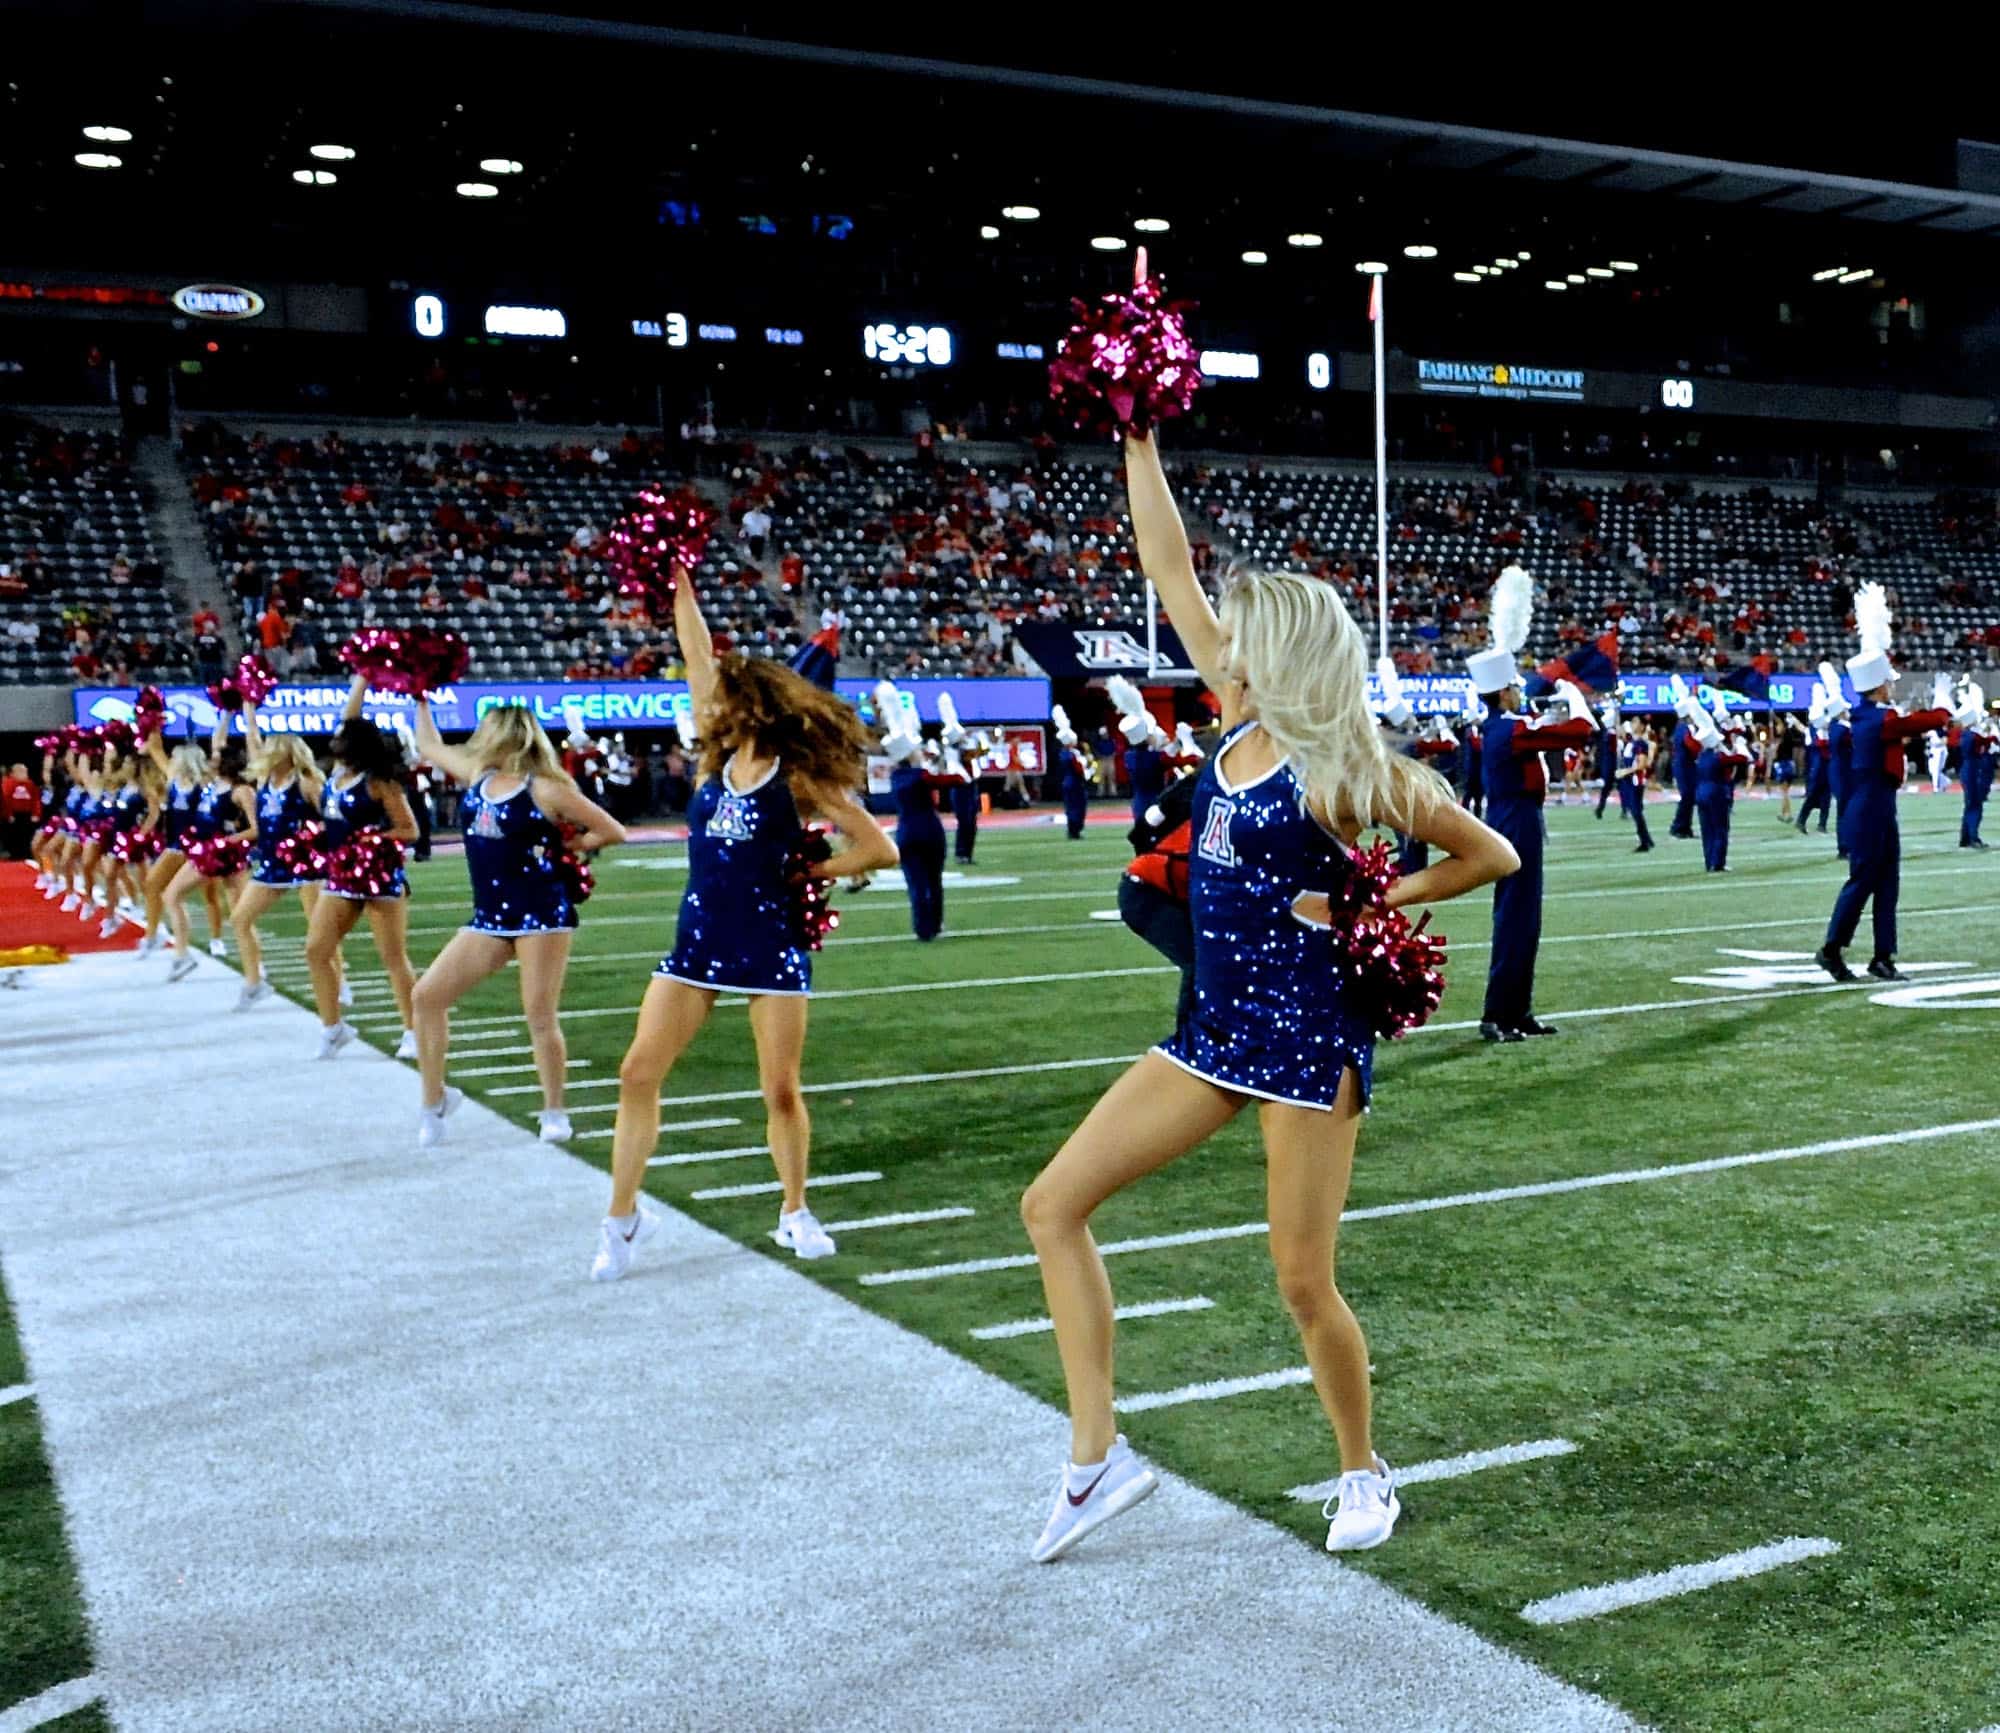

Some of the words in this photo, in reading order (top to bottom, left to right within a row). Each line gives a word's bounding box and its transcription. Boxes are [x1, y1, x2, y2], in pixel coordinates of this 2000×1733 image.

[415, 295, 443, 336] 0
[666, 312, 688, 346] 3
[1309, 353, 1329, 388] 0
[1199, 796, 1236, 868] A
